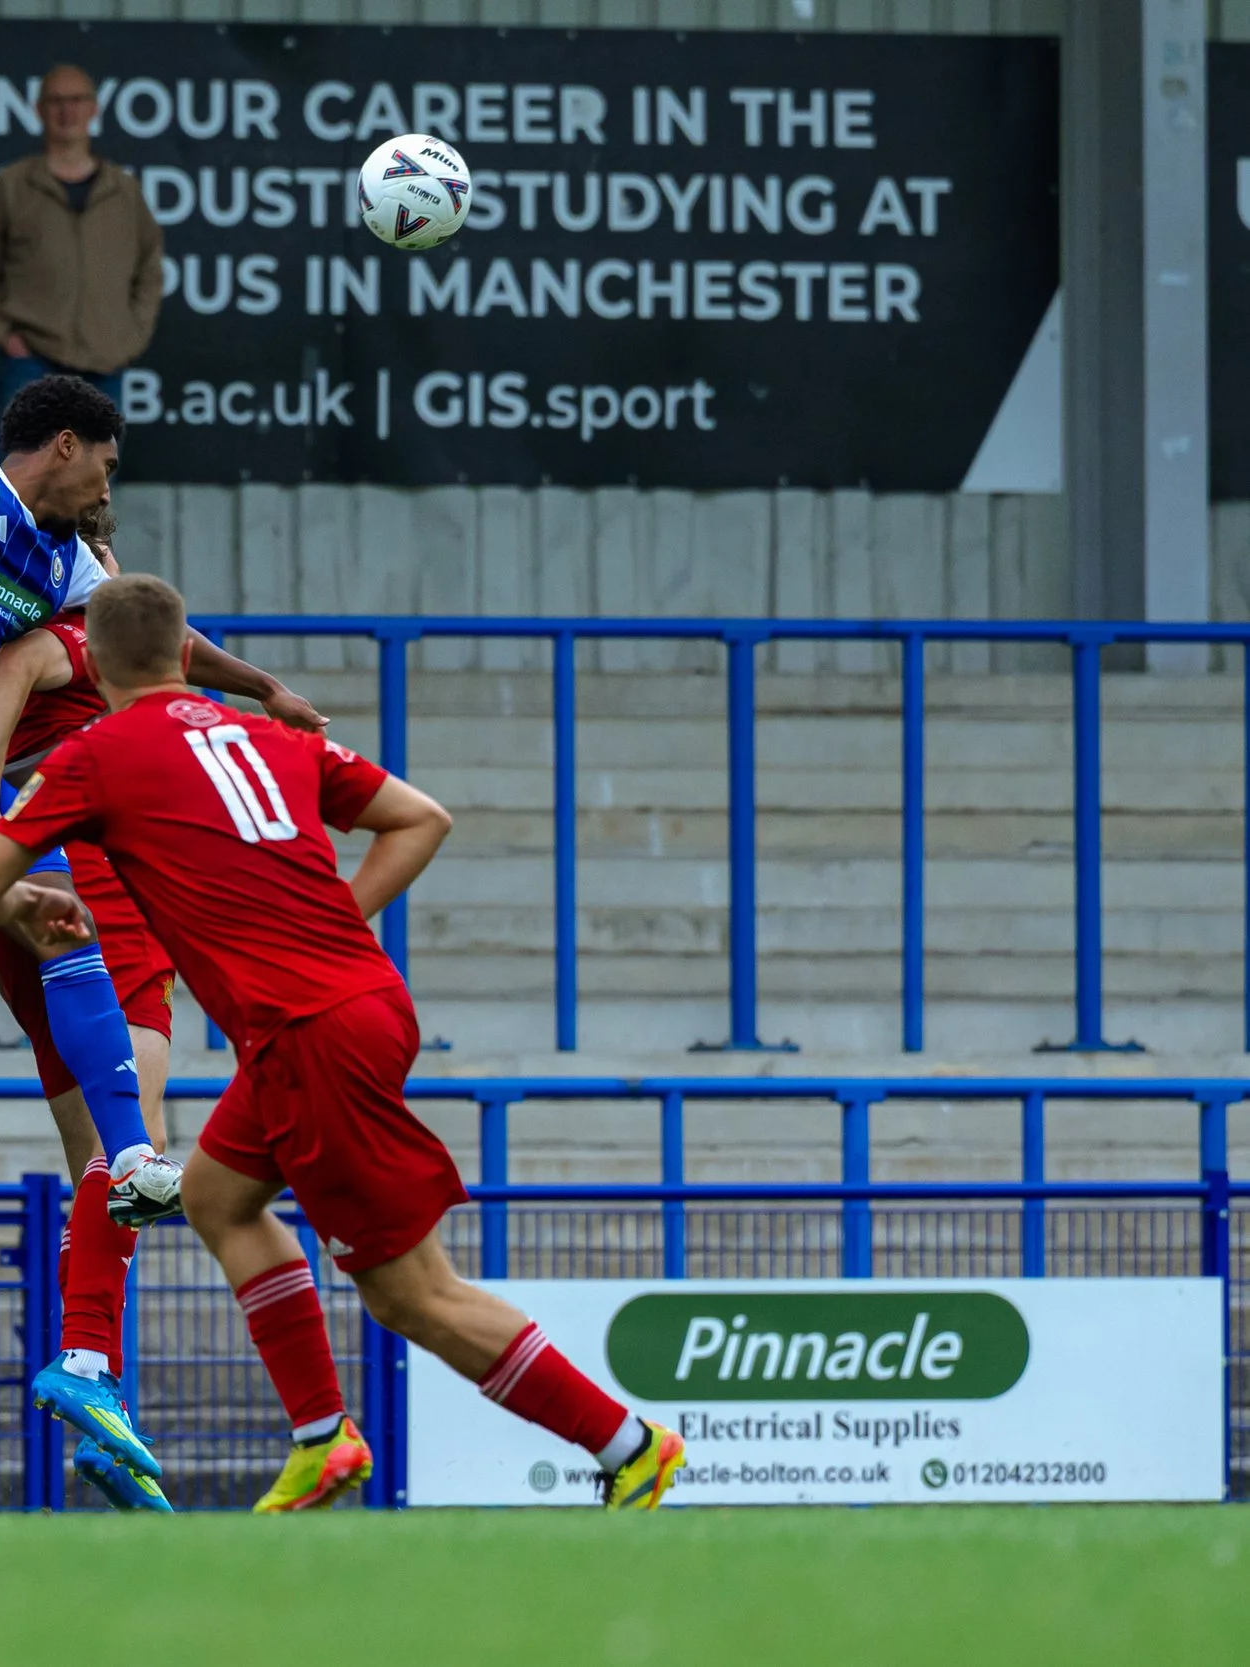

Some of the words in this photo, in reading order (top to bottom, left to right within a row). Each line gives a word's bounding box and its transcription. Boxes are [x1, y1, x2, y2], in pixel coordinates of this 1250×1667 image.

[303, 80, 607, 144] CAREER
[632, 84, 706, 145] IN
[729, 88, 875, 148] THE
[463, 170, 836, 235] STUDYING
[859, 177, 952, 236] AT
[306, 255, 381, 316] IN
[407, 257, 921, 324] MANCHESTER
[412, 370, 717, 442] GIS.sport
[183, 725, 298, 843] 10
[674, 1312, 963, 1381] Pinnacle
[676, 1411, 823, 1440] Electrical
[832, 1410, 961, 1448] Supplies
[952, 1461, 1107, 1485] 01204232800
